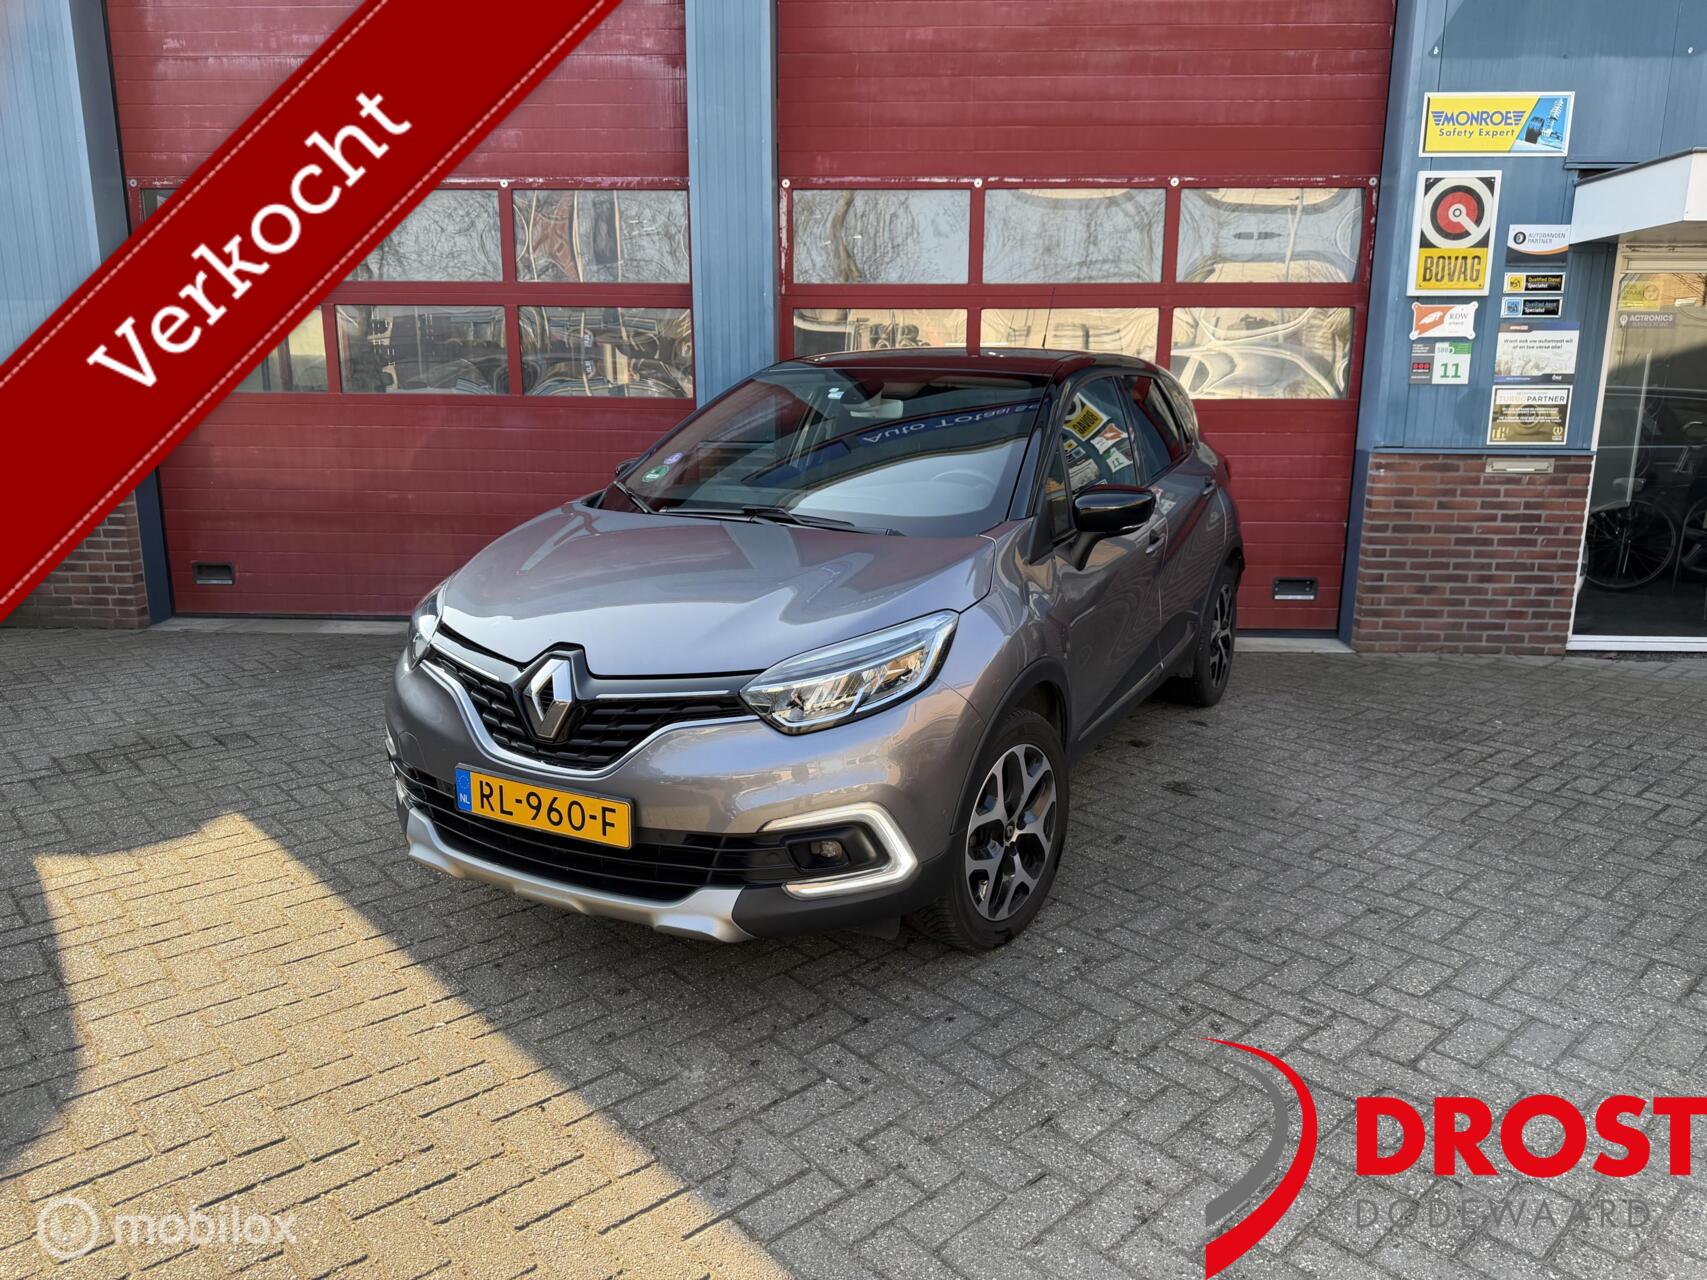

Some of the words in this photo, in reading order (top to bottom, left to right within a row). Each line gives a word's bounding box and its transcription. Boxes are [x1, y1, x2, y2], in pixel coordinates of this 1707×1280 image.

[1441, 111, 1514, 126] MONROE
[1438, 128, 1474, 139] Safety
[1478, 128, 1515, 139] Expert
[1422, 255, 1482, 283] BOVAG
[1629, 314, 1673, 322] ACTRONICS
[1439, 362, 1461, 378] 11
[1527, 395, 1565, 403] PARTNER
[459, 793, 471, 805] NL
[479, 780, 617, 837] RL-960-F
